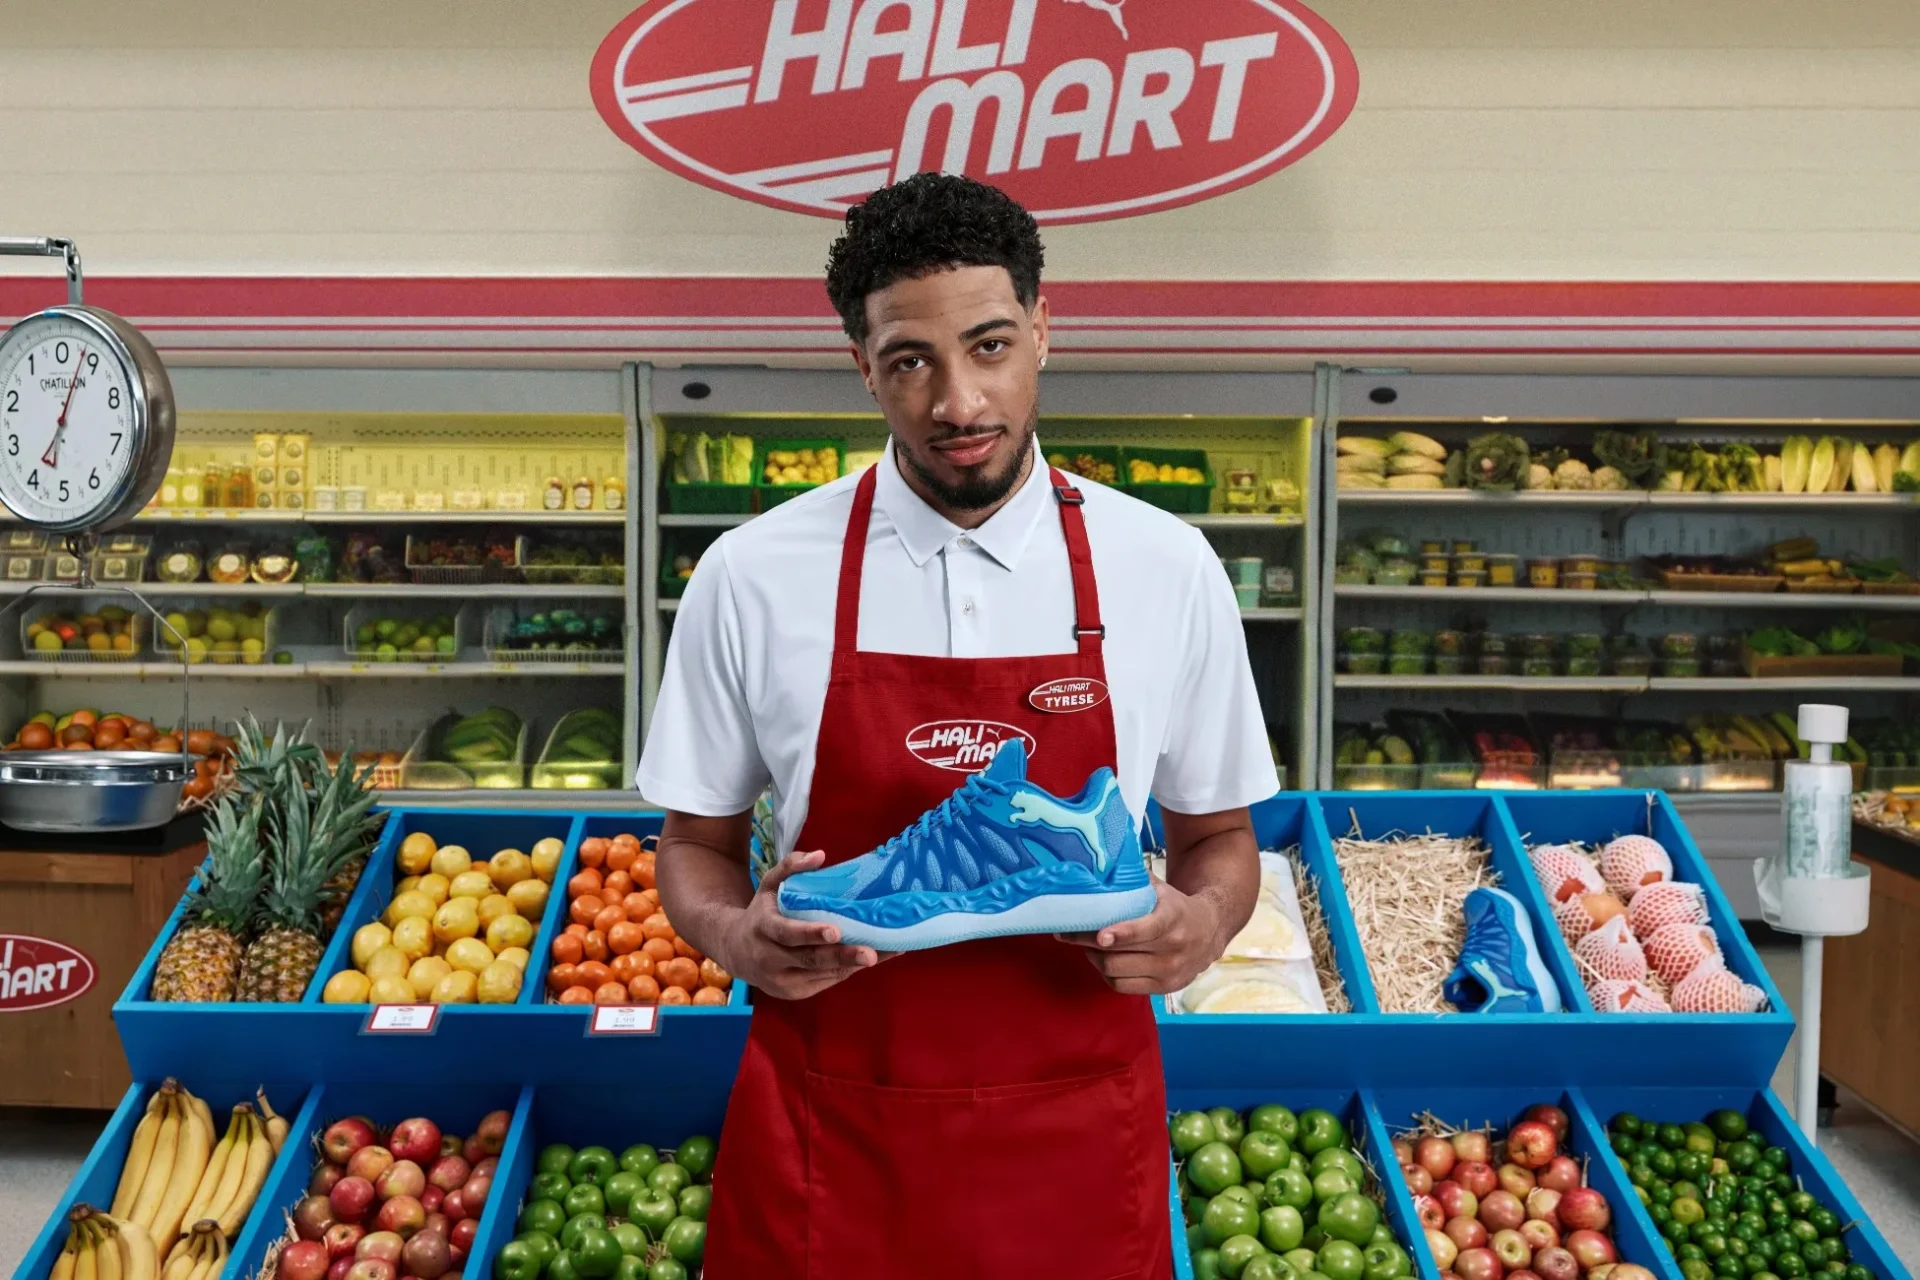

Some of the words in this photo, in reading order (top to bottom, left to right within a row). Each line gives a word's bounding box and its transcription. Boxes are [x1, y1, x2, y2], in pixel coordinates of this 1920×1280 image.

[754, 0, 1037, 103] HALI
[893, 31, 1279, 185] MART
[56, 342, 69, 363] 0
[28, 353, 34, 375] 1
[87, 353, 99, 375] 9
[40, 376, 86, 392] CHATILLON
[7, 390, 19, 412] 2
[108, 387, 120, 409] 8
[8, 434, 19, 456] 3
[110, 433, 122, 455] 7
[27, 468, 39, 491] 4
[88, 467, 100, 490] 6
[59, 480, 69, 502] 5
[1045, 693, 1094, 708] TYRESE
[931, 724, 984, 748] HALI
